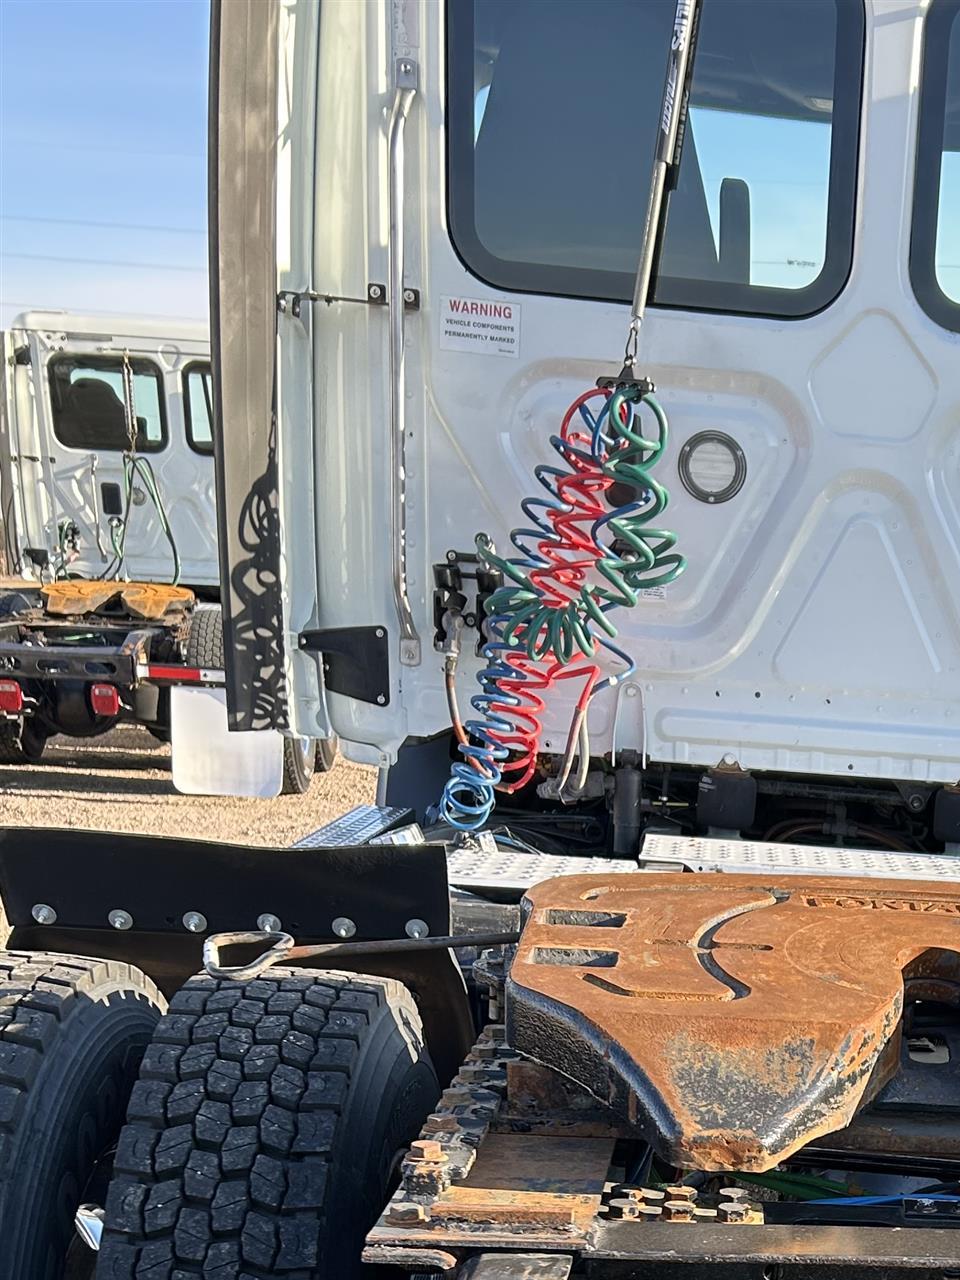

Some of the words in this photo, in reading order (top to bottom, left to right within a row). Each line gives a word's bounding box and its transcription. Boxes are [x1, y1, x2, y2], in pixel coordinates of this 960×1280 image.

[449, 299, 512, 319] WARNING
[445, 318, 471, 328] VEHICLE
[472, 321, 514, 332] COMPONENTS
[444, 330, 488, 341] PERMANENTLY
[489, 335, 515, 344] MARKED
